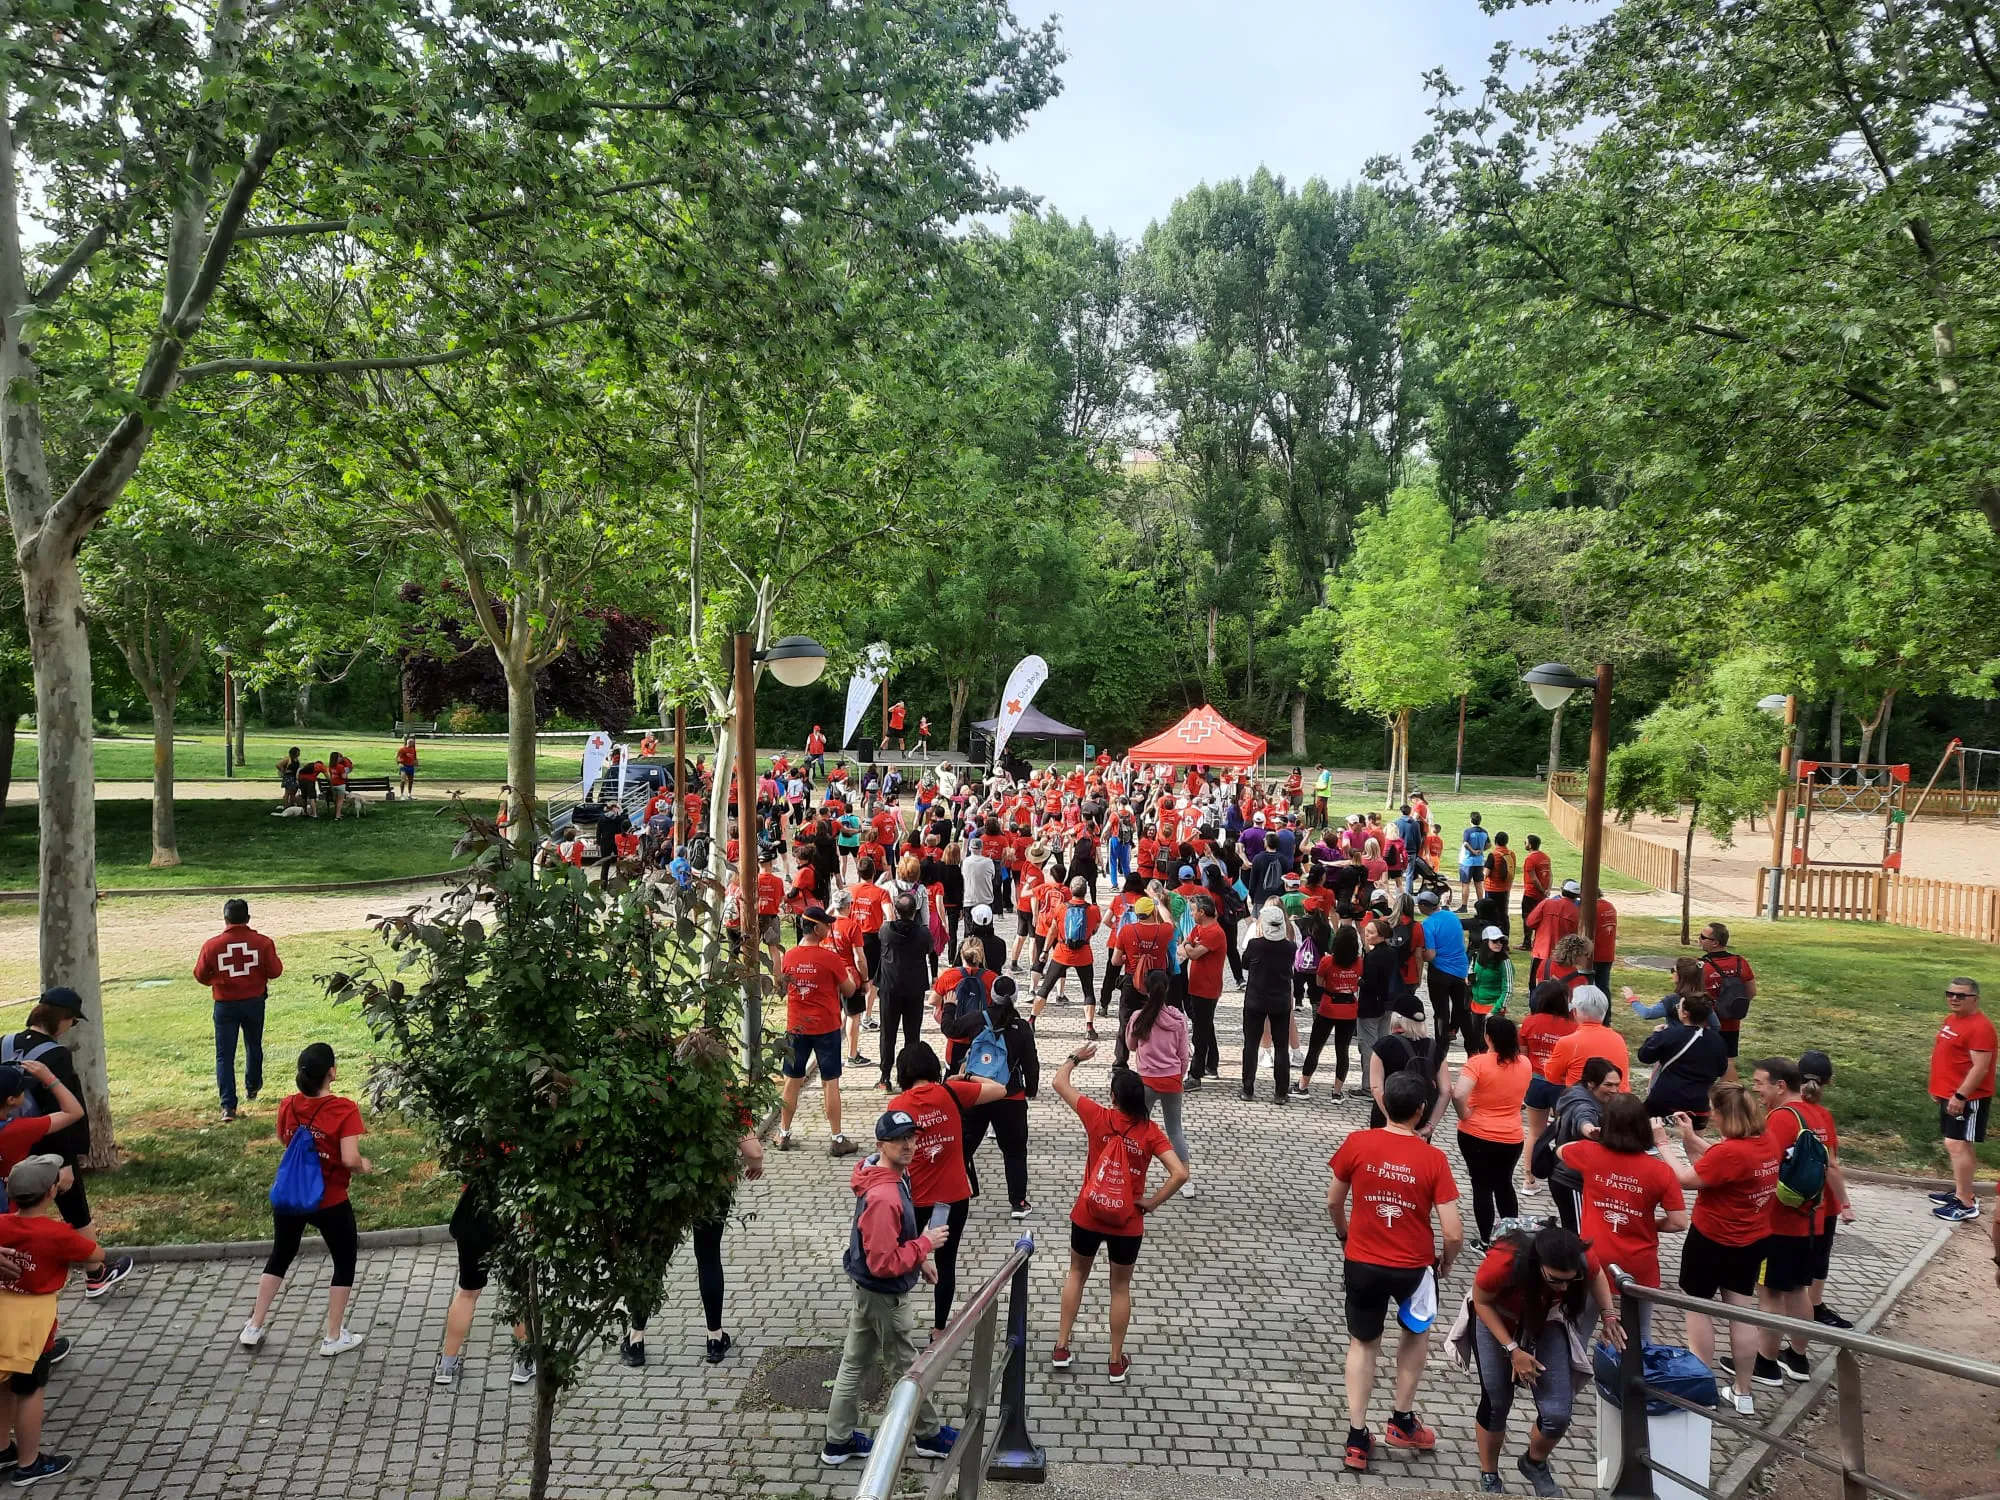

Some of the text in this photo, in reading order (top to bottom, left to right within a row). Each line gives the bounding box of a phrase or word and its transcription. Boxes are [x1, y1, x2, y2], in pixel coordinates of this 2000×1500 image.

[1378, 1168, 1416, 1185] PASTOR
[1605, 1178, 1643, 1194] PASTOR
[1363, 1195, 1417, 1210] TORREMILANOS
[1377, 1190, 1402, 1200] FINCA
[1605, 1197, 1629, 1207] FINCA
[1593, 1200, 1643, 1218] TORREMILANOS
